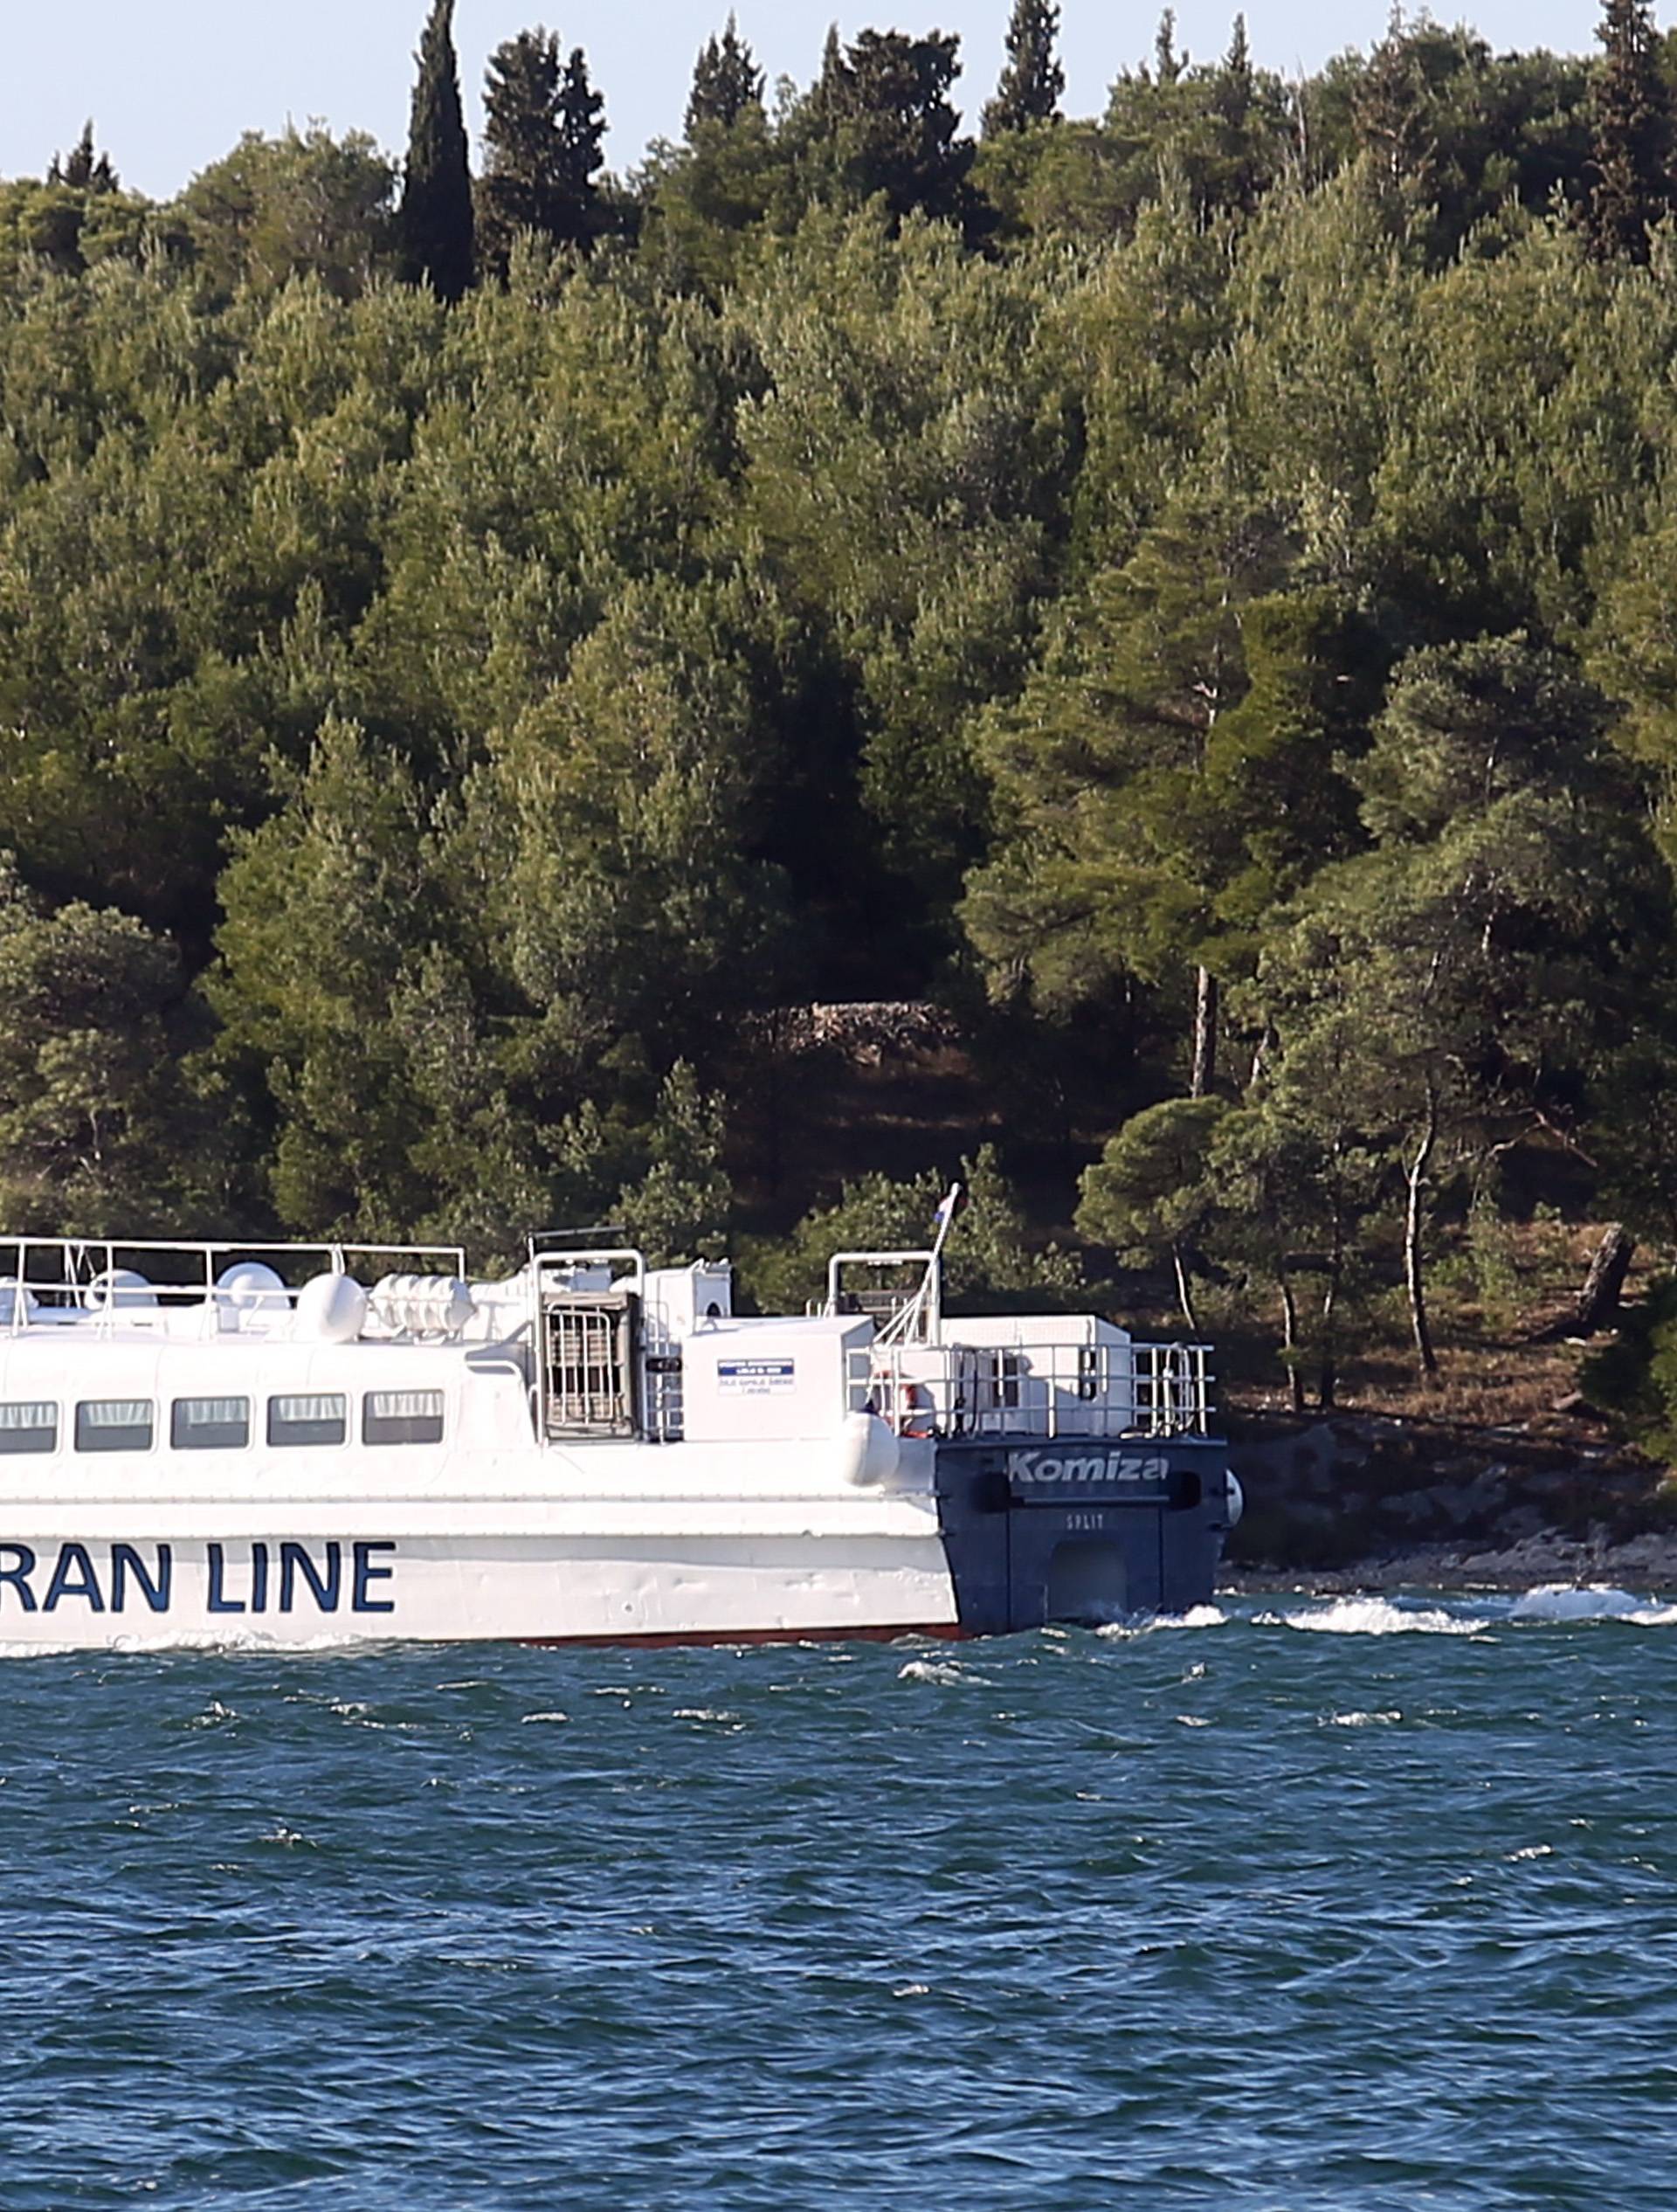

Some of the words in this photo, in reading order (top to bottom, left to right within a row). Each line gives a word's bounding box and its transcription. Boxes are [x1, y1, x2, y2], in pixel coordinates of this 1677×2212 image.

[1008, 1450, 1170, 1483] Komiza
[1066, 1514, 1104, 1531] SPLIT
[206, 1541, 397, 1614] LINE
